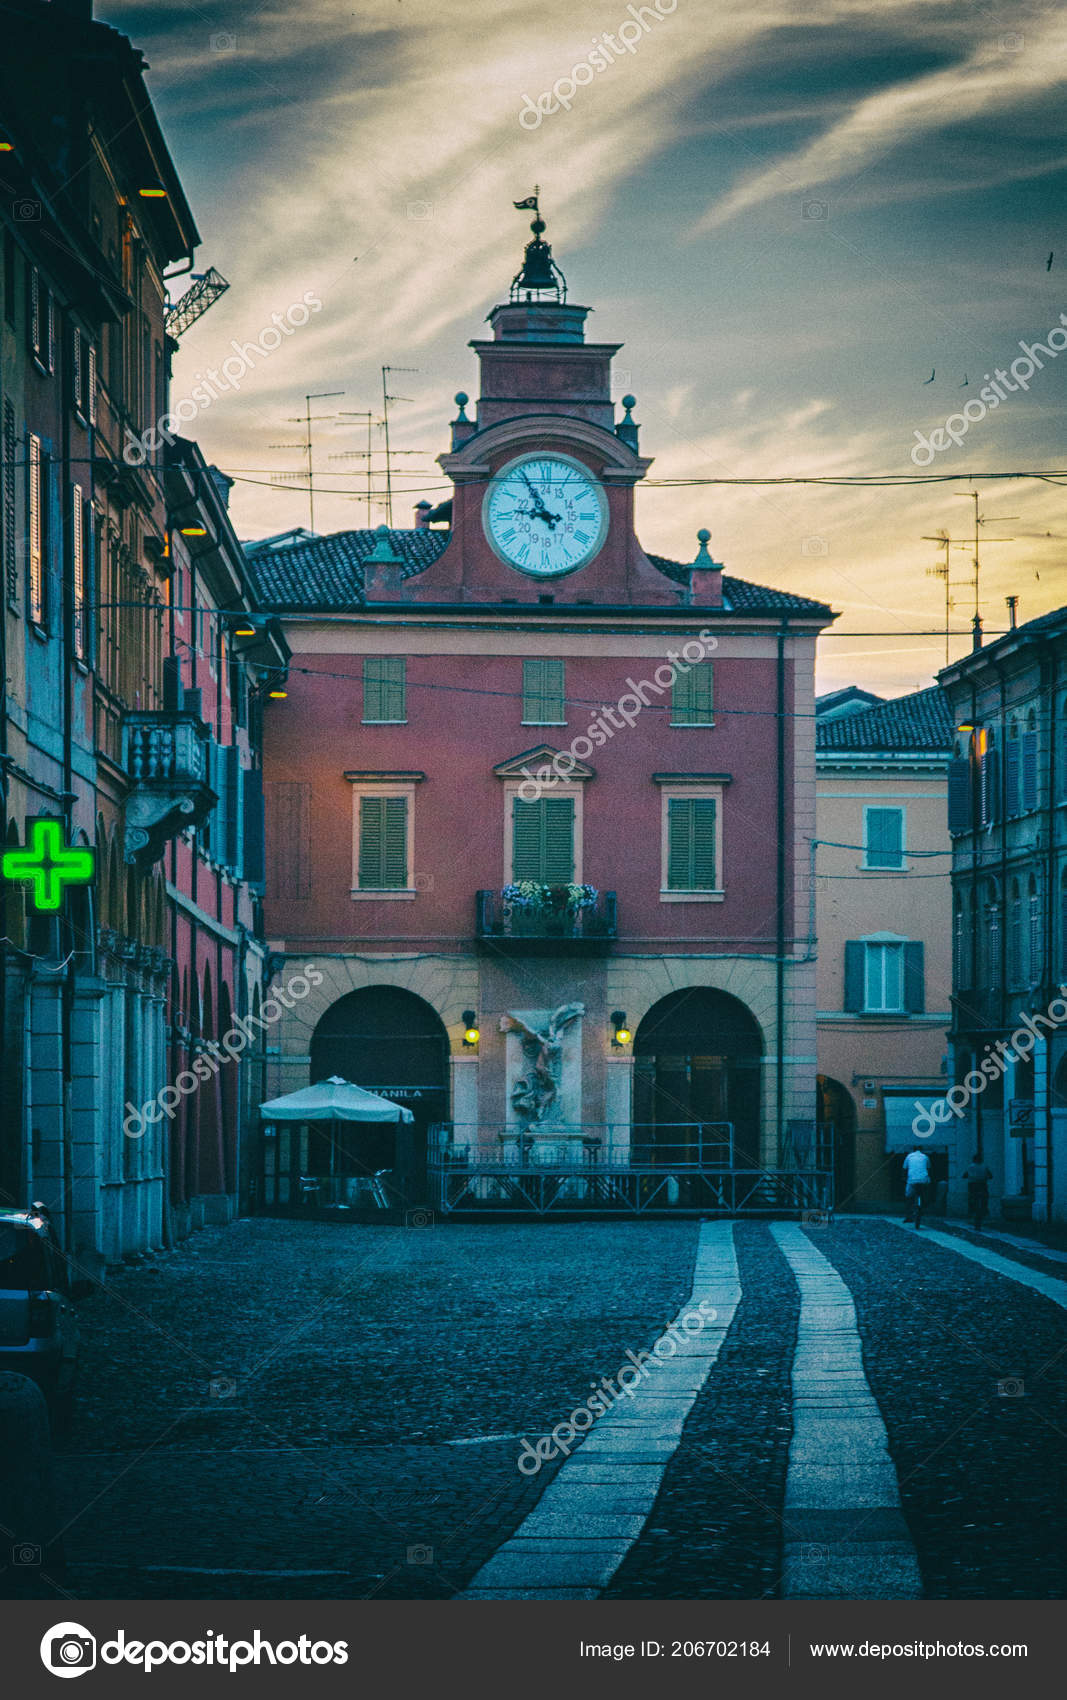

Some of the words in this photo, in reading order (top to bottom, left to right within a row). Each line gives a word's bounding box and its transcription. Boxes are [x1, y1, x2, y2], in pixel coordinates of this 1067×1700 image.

[540, 485, 551, 495] 24
[554, 488, 565, 499] 13
[564, 499, 574, 510] 14
[566, 512, 577, 521] 15
[518, 522, 531, 533] 20
[564, 522, 574, 533] 16
[528, 533, 539, 544] 19
[554, 533, 564, 544] 17
